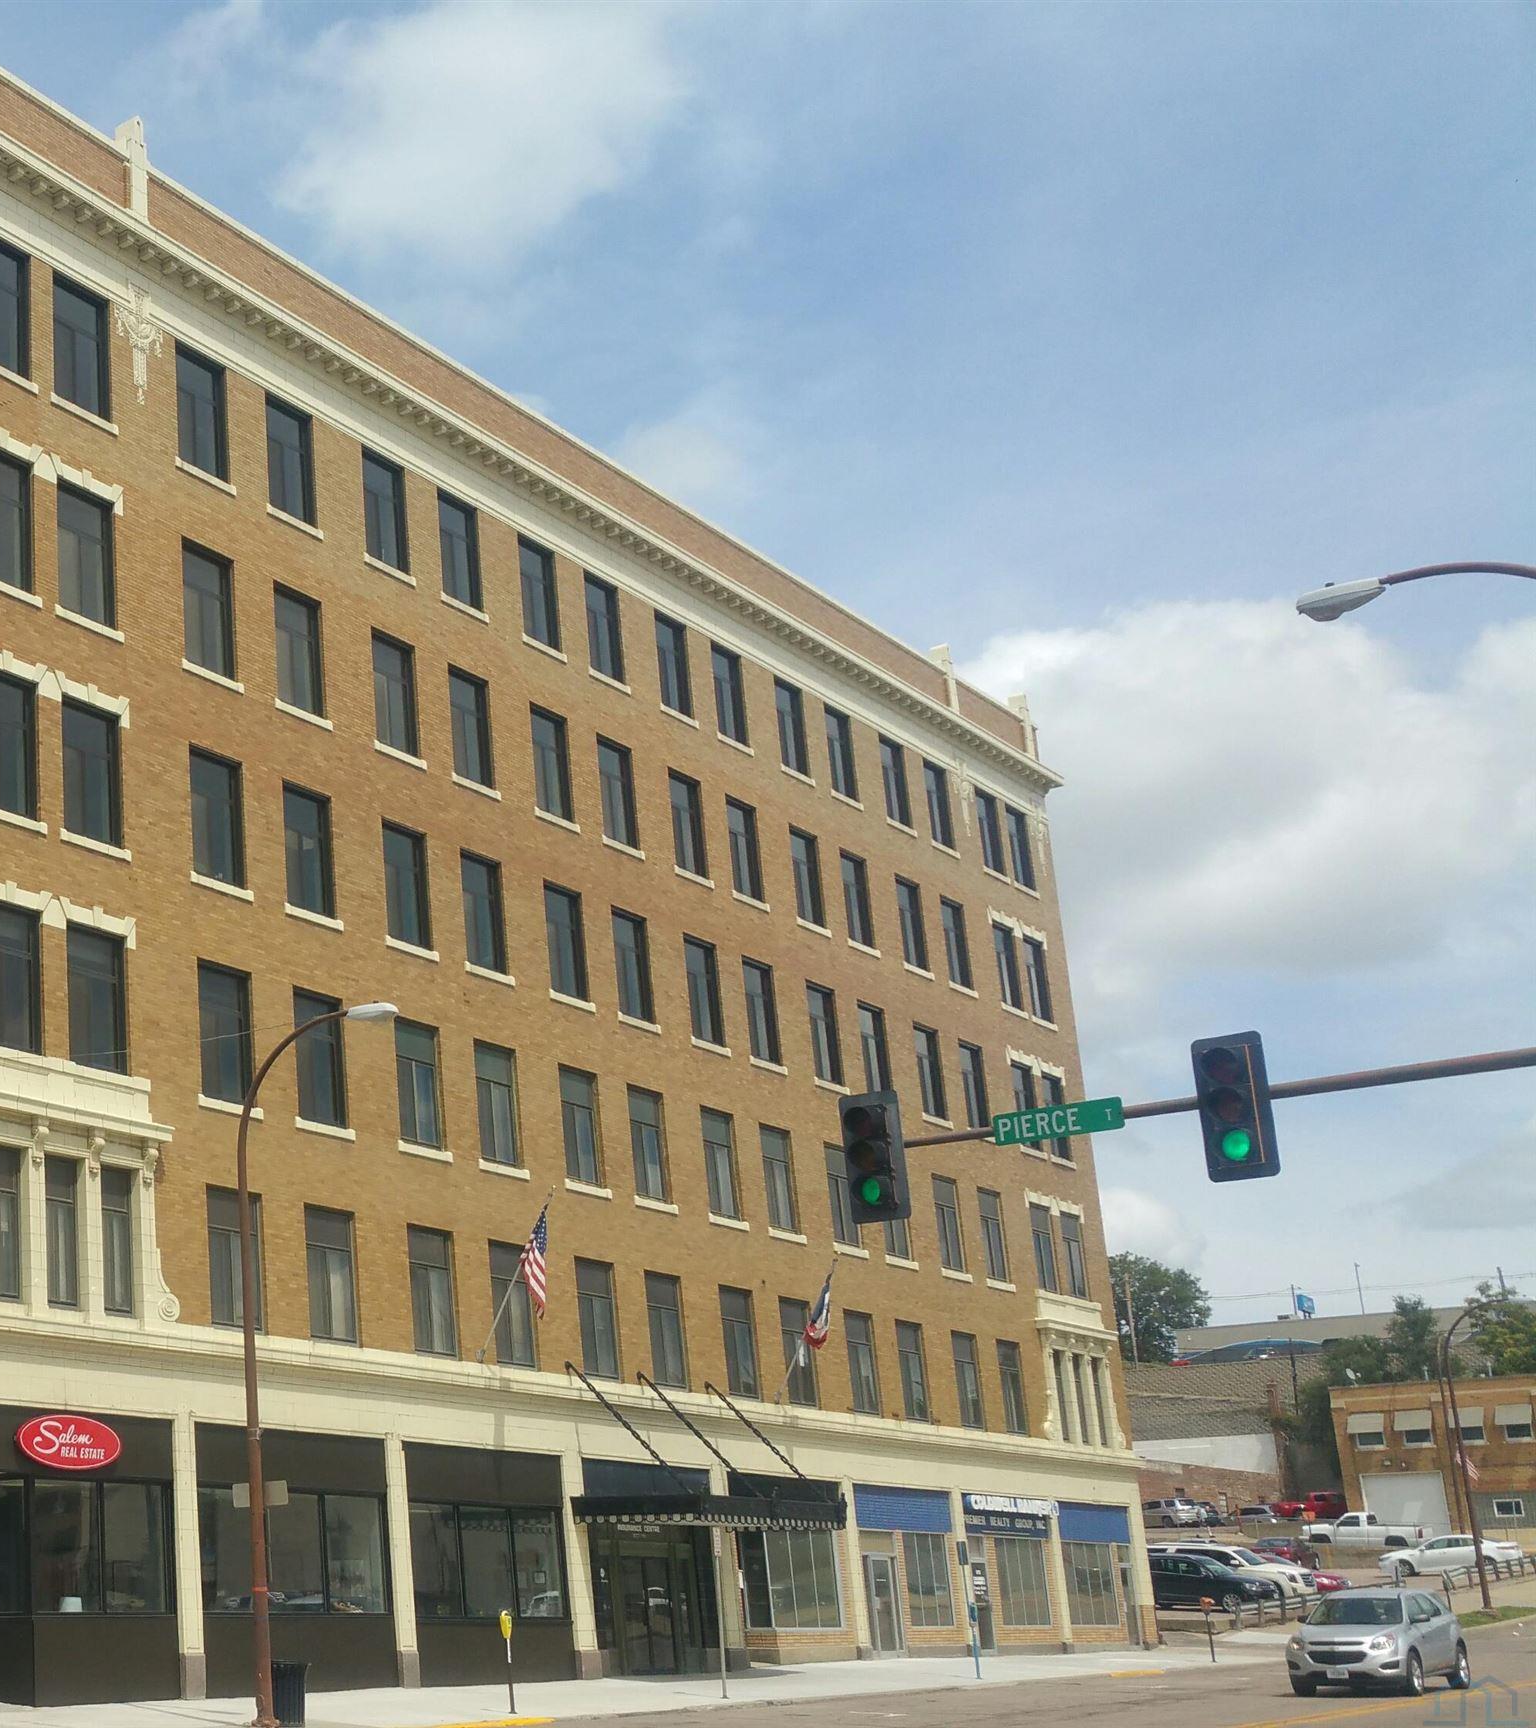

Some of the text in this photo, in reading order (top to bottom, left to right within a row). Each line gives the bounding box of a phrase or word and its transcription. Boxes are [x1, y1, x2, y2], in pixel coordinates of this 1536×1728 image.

[998, 1108, 1081, 1141] PIERCE
[33, 1421, 93, 1454] Salem
[60, 1446, 105, 1460] REAL ESTATE
[965, 1515, 985, 1525] REMIER
